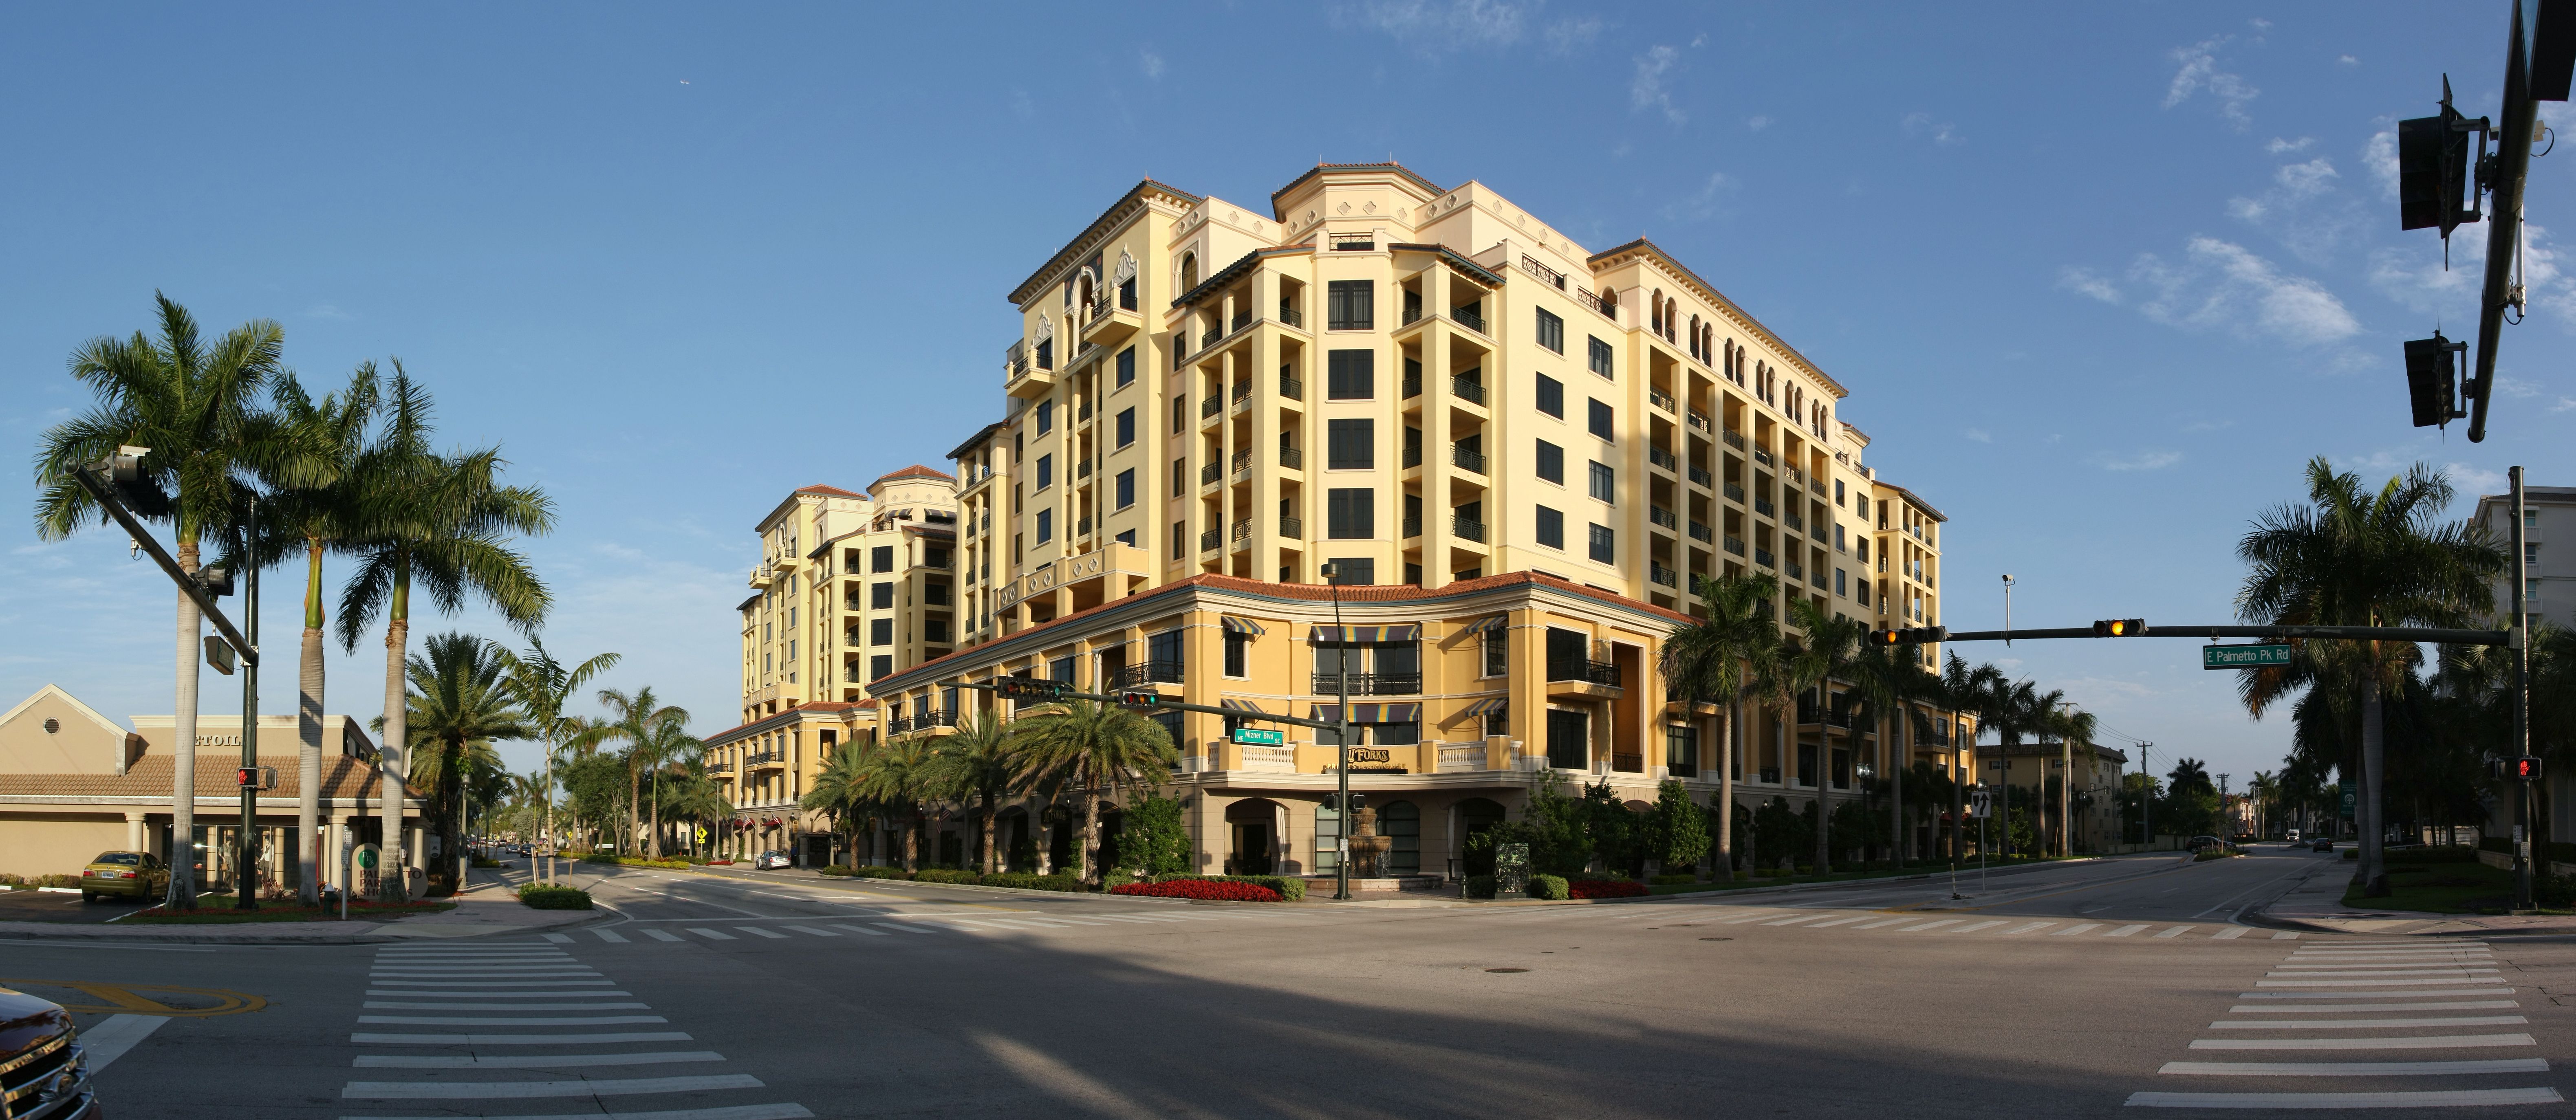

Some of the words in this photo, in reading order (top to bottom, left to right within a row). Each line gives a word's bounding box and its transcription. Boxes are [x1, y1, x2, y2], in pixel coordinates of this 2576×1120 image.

[2207, 651, 2213, 662] E
[2217, 651, 2256, 662] Palmetto
[2261, 650, 2272, 660] Pk
[2277, 649, 2288, 660] Rd
[195, 735, 243, 746] ETOIL
[1355, 749, 1388, 761] FORKS
[360, 879, 381, 887] PAR
